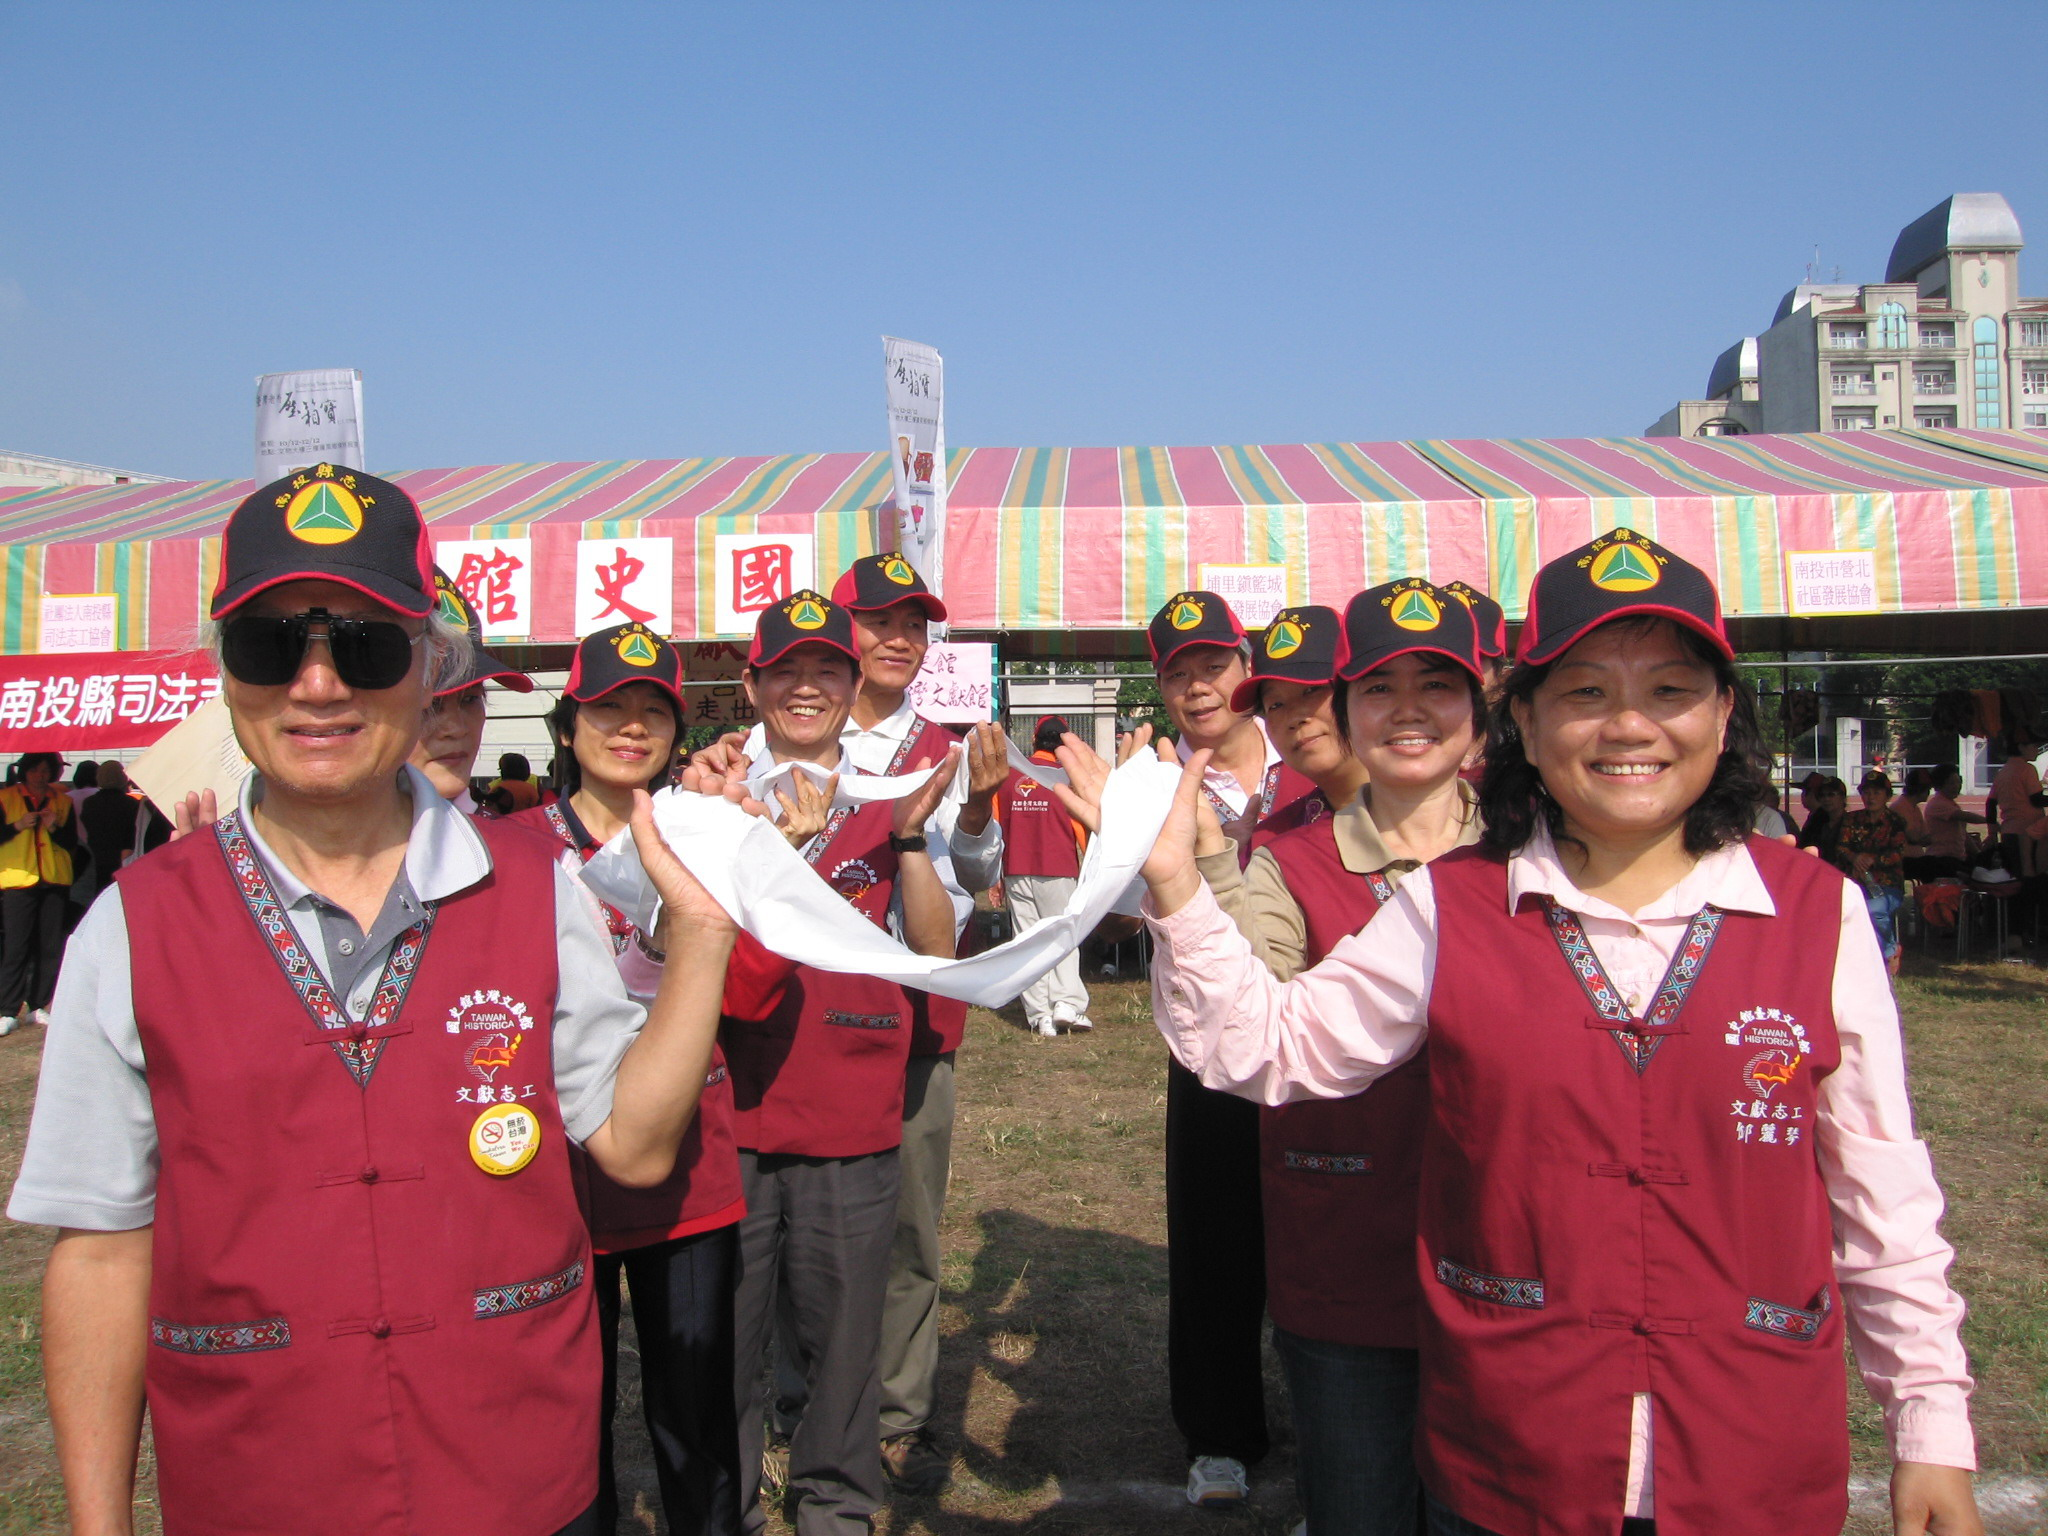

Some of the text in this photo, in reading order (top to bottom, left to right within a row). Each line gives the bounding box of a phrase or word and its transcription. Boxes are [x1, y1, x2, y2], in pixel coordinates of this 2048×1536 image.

[1794, 559, 1871, 580] 南投市營北
[1796, 583, 1872, 607] 社區發展協會
[1227, 599, 1283, 621] 發展協會
[464, 1019, 516, 1031] HISTORICA
[471, 1012, 507, 1023] TAIWAN
[1744, 1034, 1796, 1048] HISTORICA
[1752, 1027, 1788, 1039] TAIWAN
[455, 1084, 538, 1104] 文獻志工
[1729, 1099, 1804, 1121] 文獻志工
